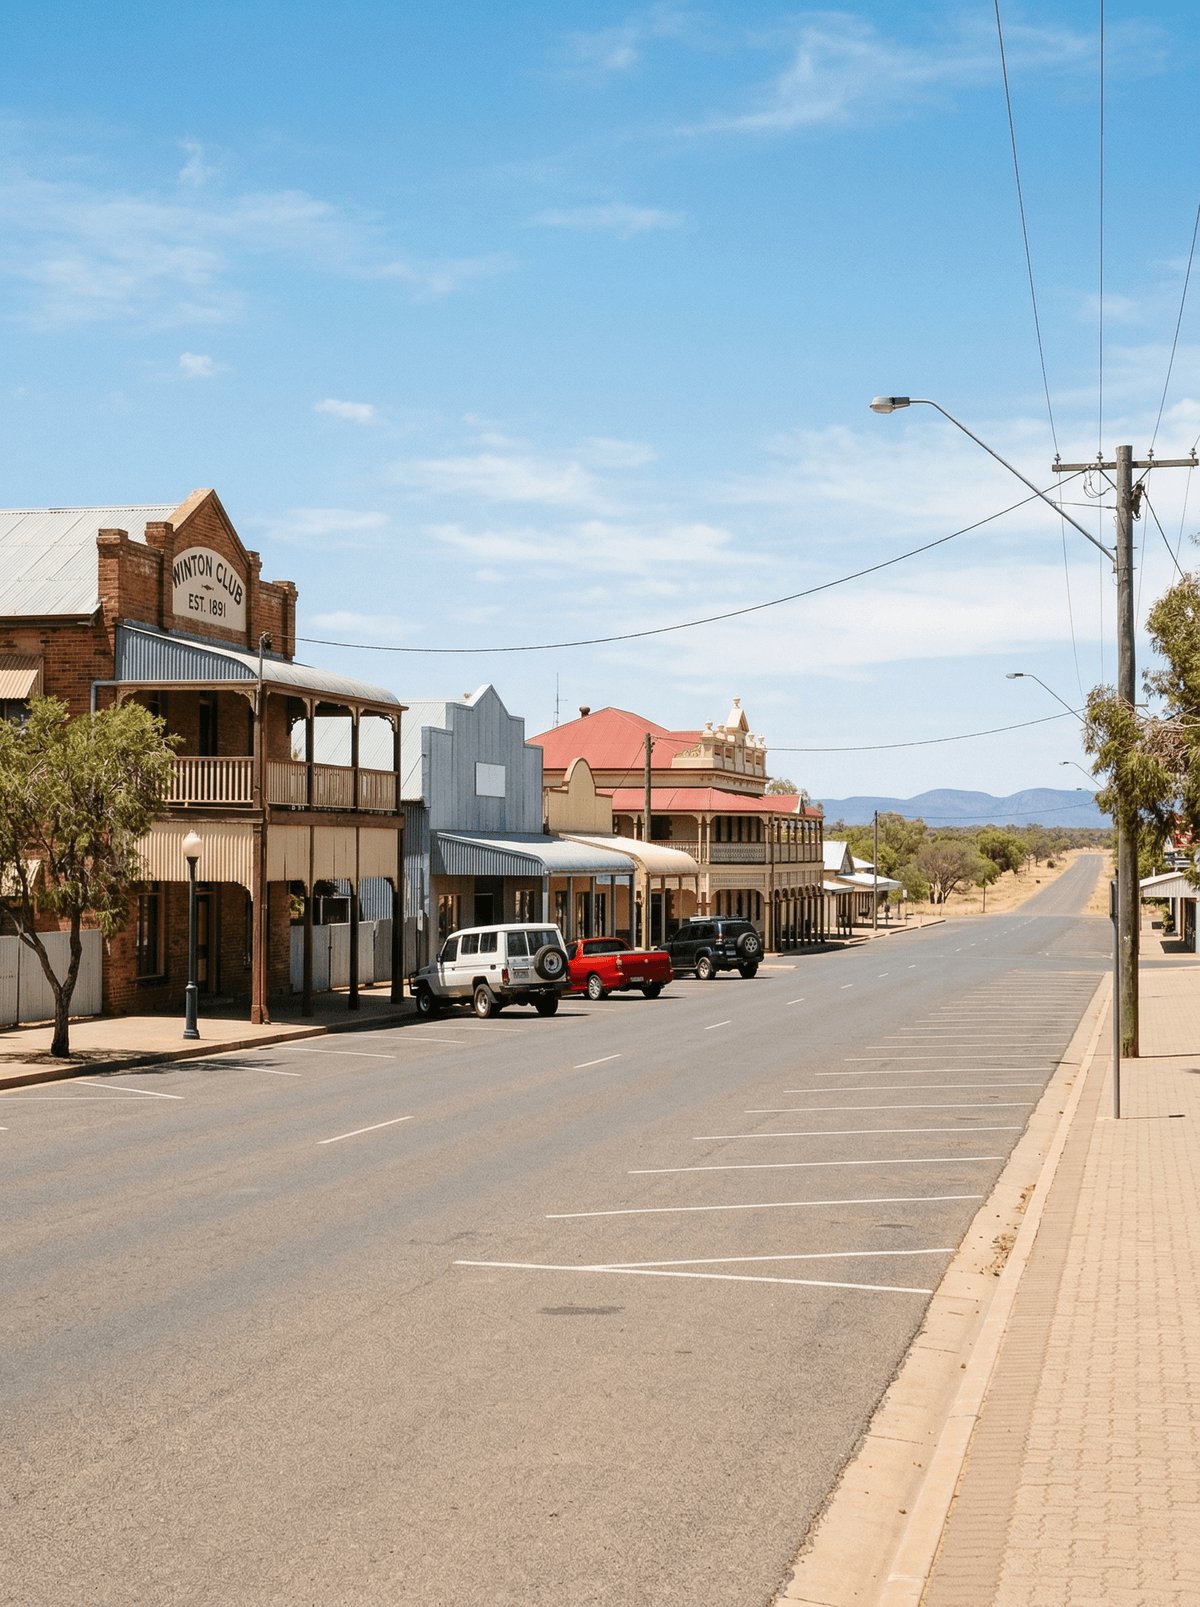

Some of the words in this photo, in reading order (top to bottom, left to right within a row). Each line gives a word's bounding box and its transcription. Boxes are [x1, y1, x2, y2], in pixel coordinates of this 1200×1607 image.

[173, 554, 212, 588] WINTON
[216, 563, 242, 605] CLUB
[189, 593, 206, 612] EST.
[209, 598, 226, 618] 1891
